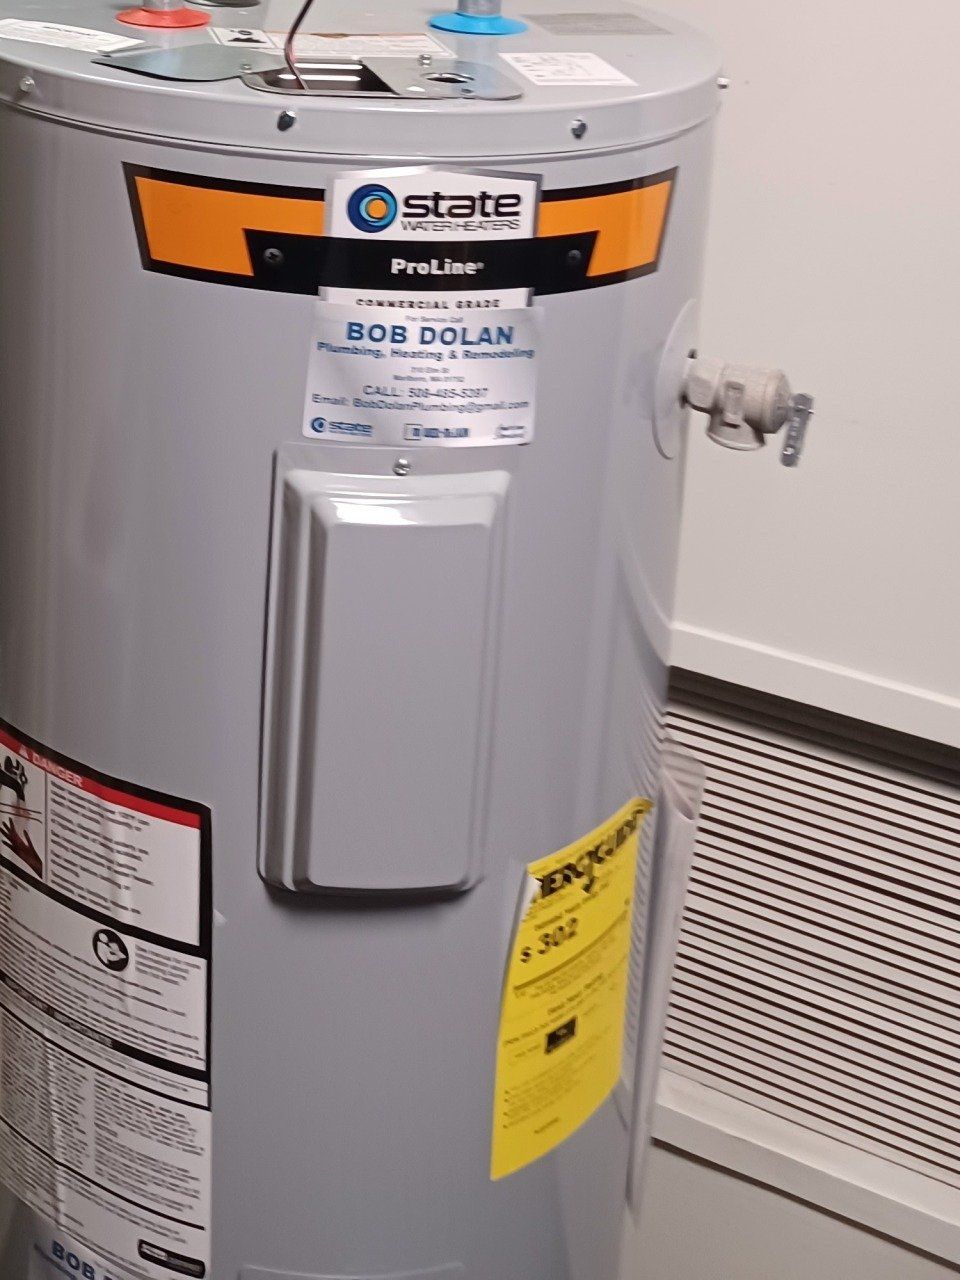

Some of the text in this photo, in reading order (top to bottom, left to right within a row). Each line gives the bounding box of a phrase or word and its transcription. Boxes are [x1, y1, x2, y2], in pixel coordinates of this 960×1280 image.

[402, 191, 521, 218] state
[401, 219, 521, 232] WATER HEATERS
[355, 298, 500, 309] COMMERCIAL GRADE
[347, 321, 514, 346] BOB DOLAN
[317, 341, 535, 362] Plumbing, Heating & Remodeling
[362, 385, 403, 397] CALL:
[311, 393, 529, 414] Email: BobDolanPlumbing@gmail.com
[329, 421, 373, 432] state
[32, 755, 84, 788] DANGER
[51, 1240, 96, 1280] BOB
